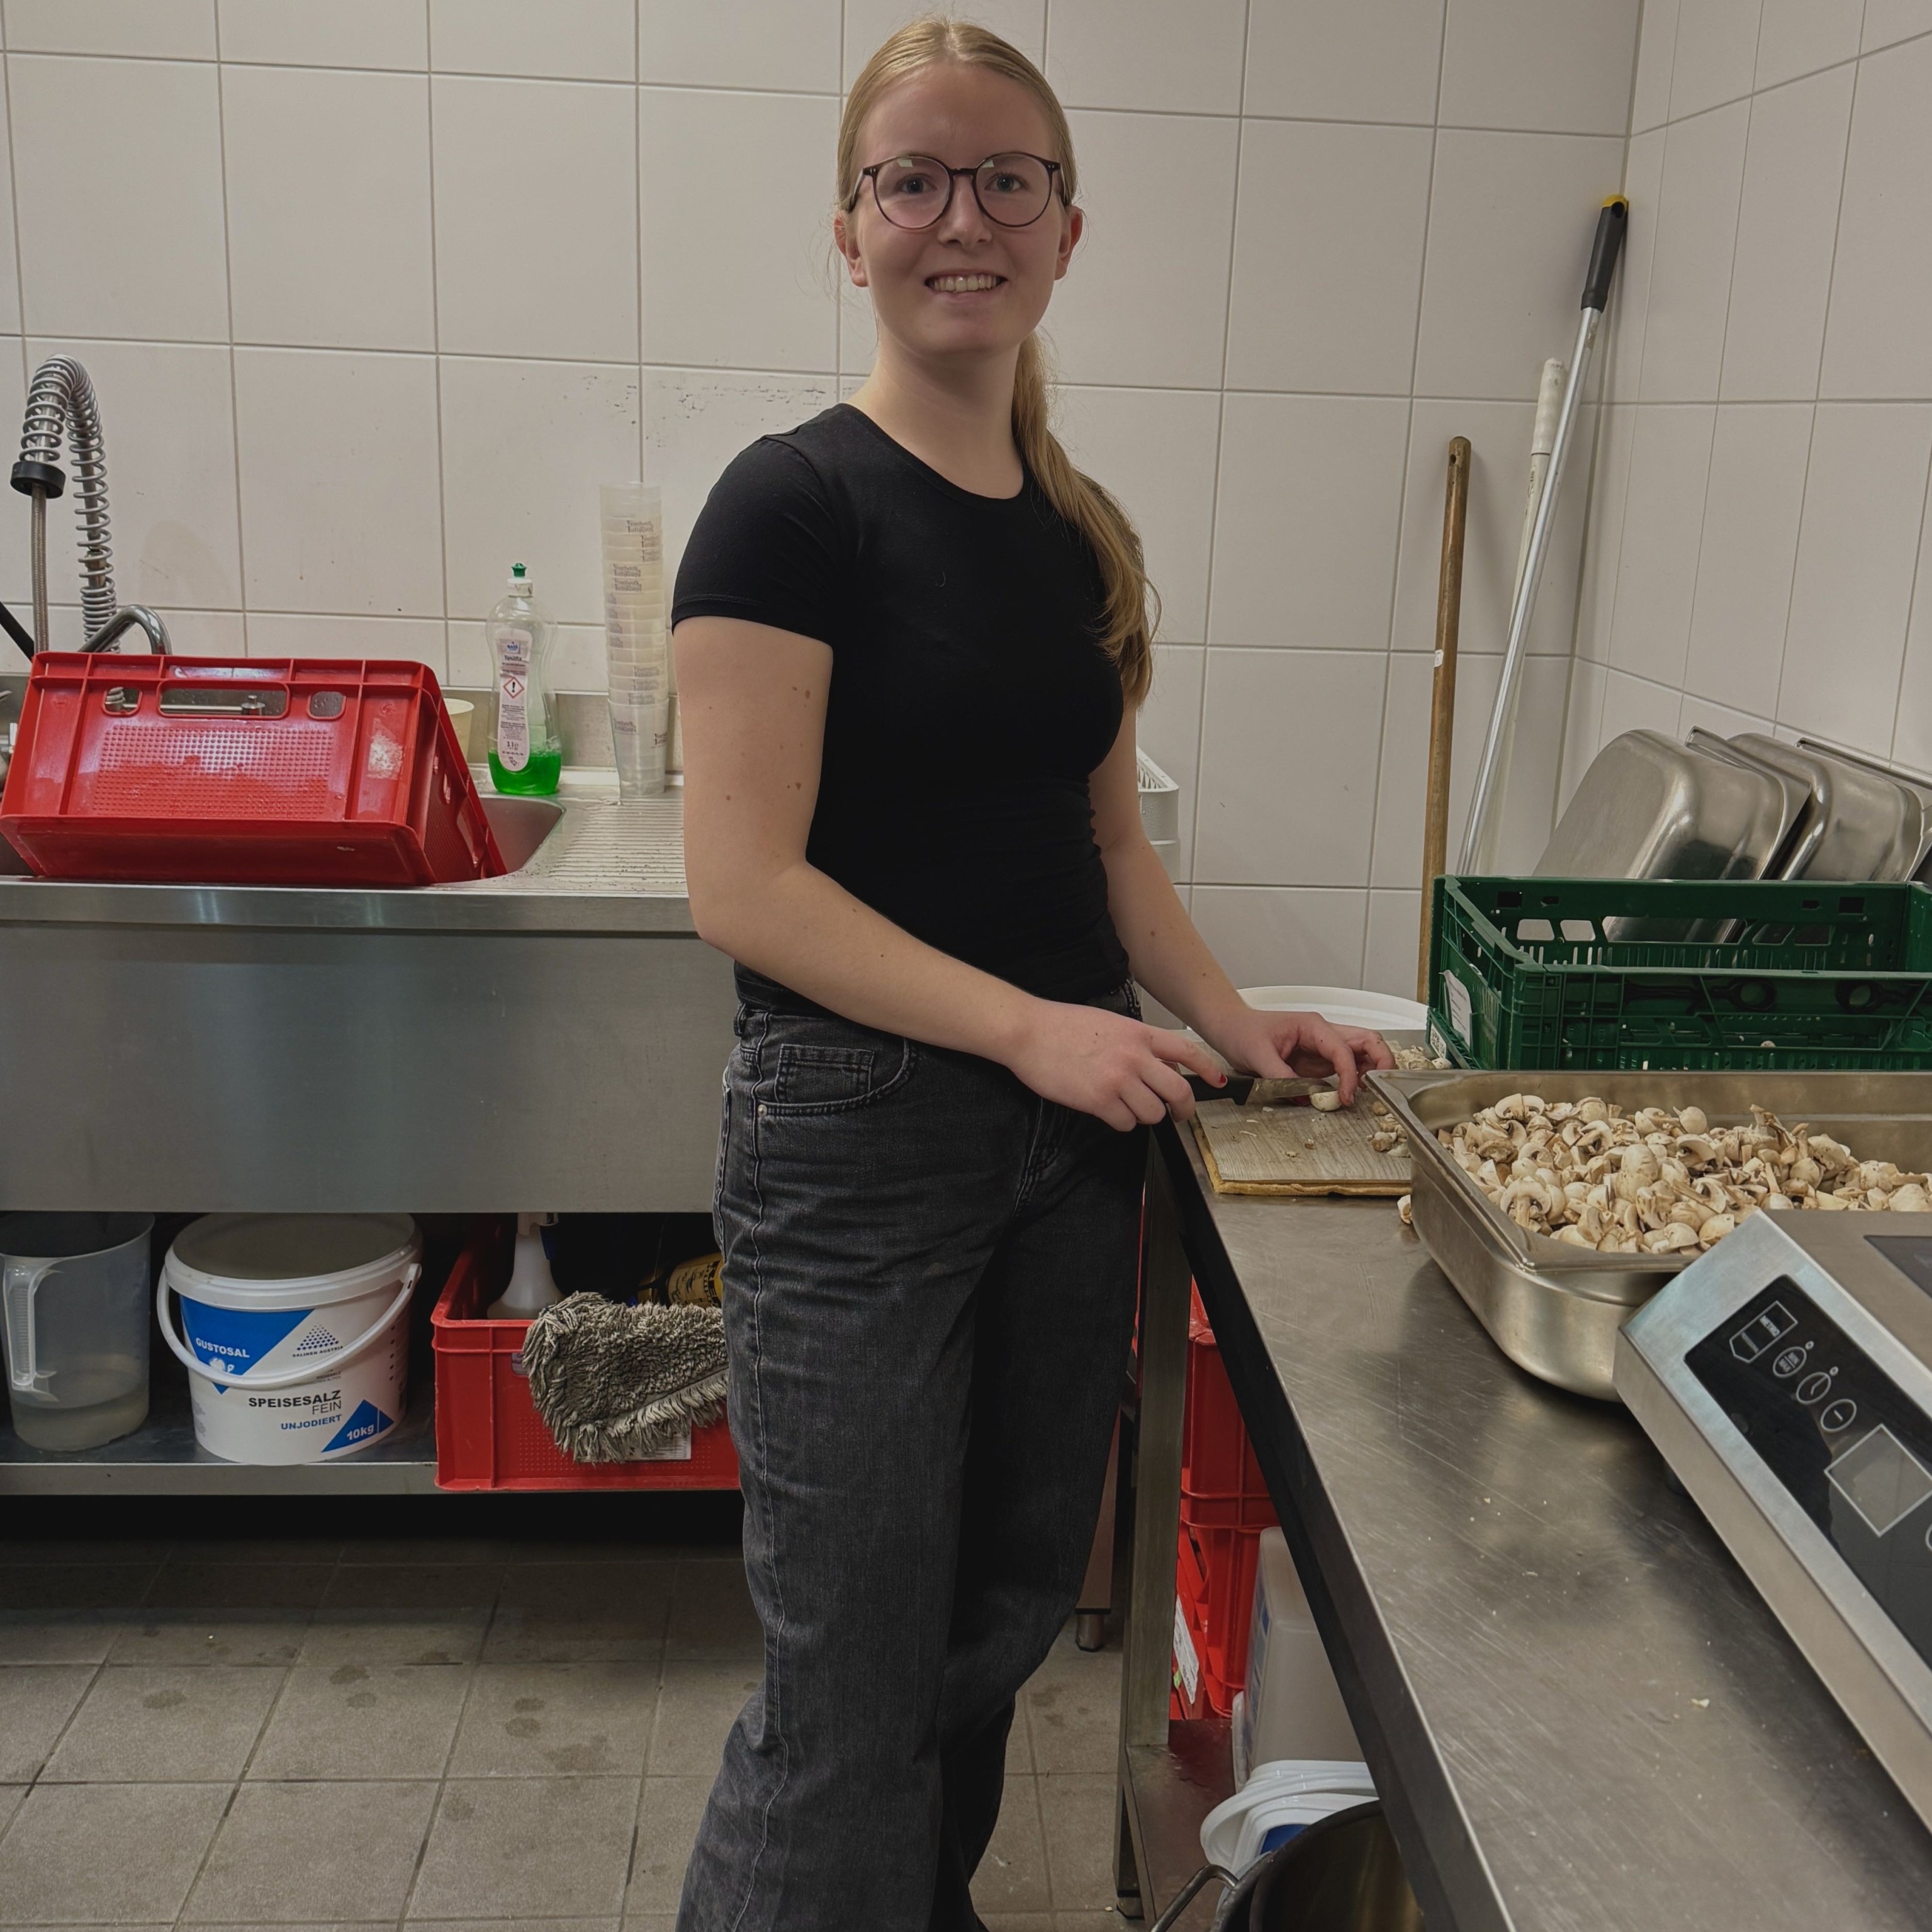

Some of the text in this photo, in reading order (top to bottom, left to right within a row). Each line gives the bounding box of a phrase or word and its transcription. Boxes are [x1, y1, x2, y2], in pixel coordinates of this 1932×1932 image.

[196, 1337, 250, 1358] GUSTOSAL
[319, 1345, 344, 1354] AUSTRIA
[249, 1390, 341, 1408] SPEISESALZ
[312, 1400, 342, 1415] FEIN
[281, 1414, 342, 1430] UNJODIERT
[347, 1424, 374, 1441] 10kg
